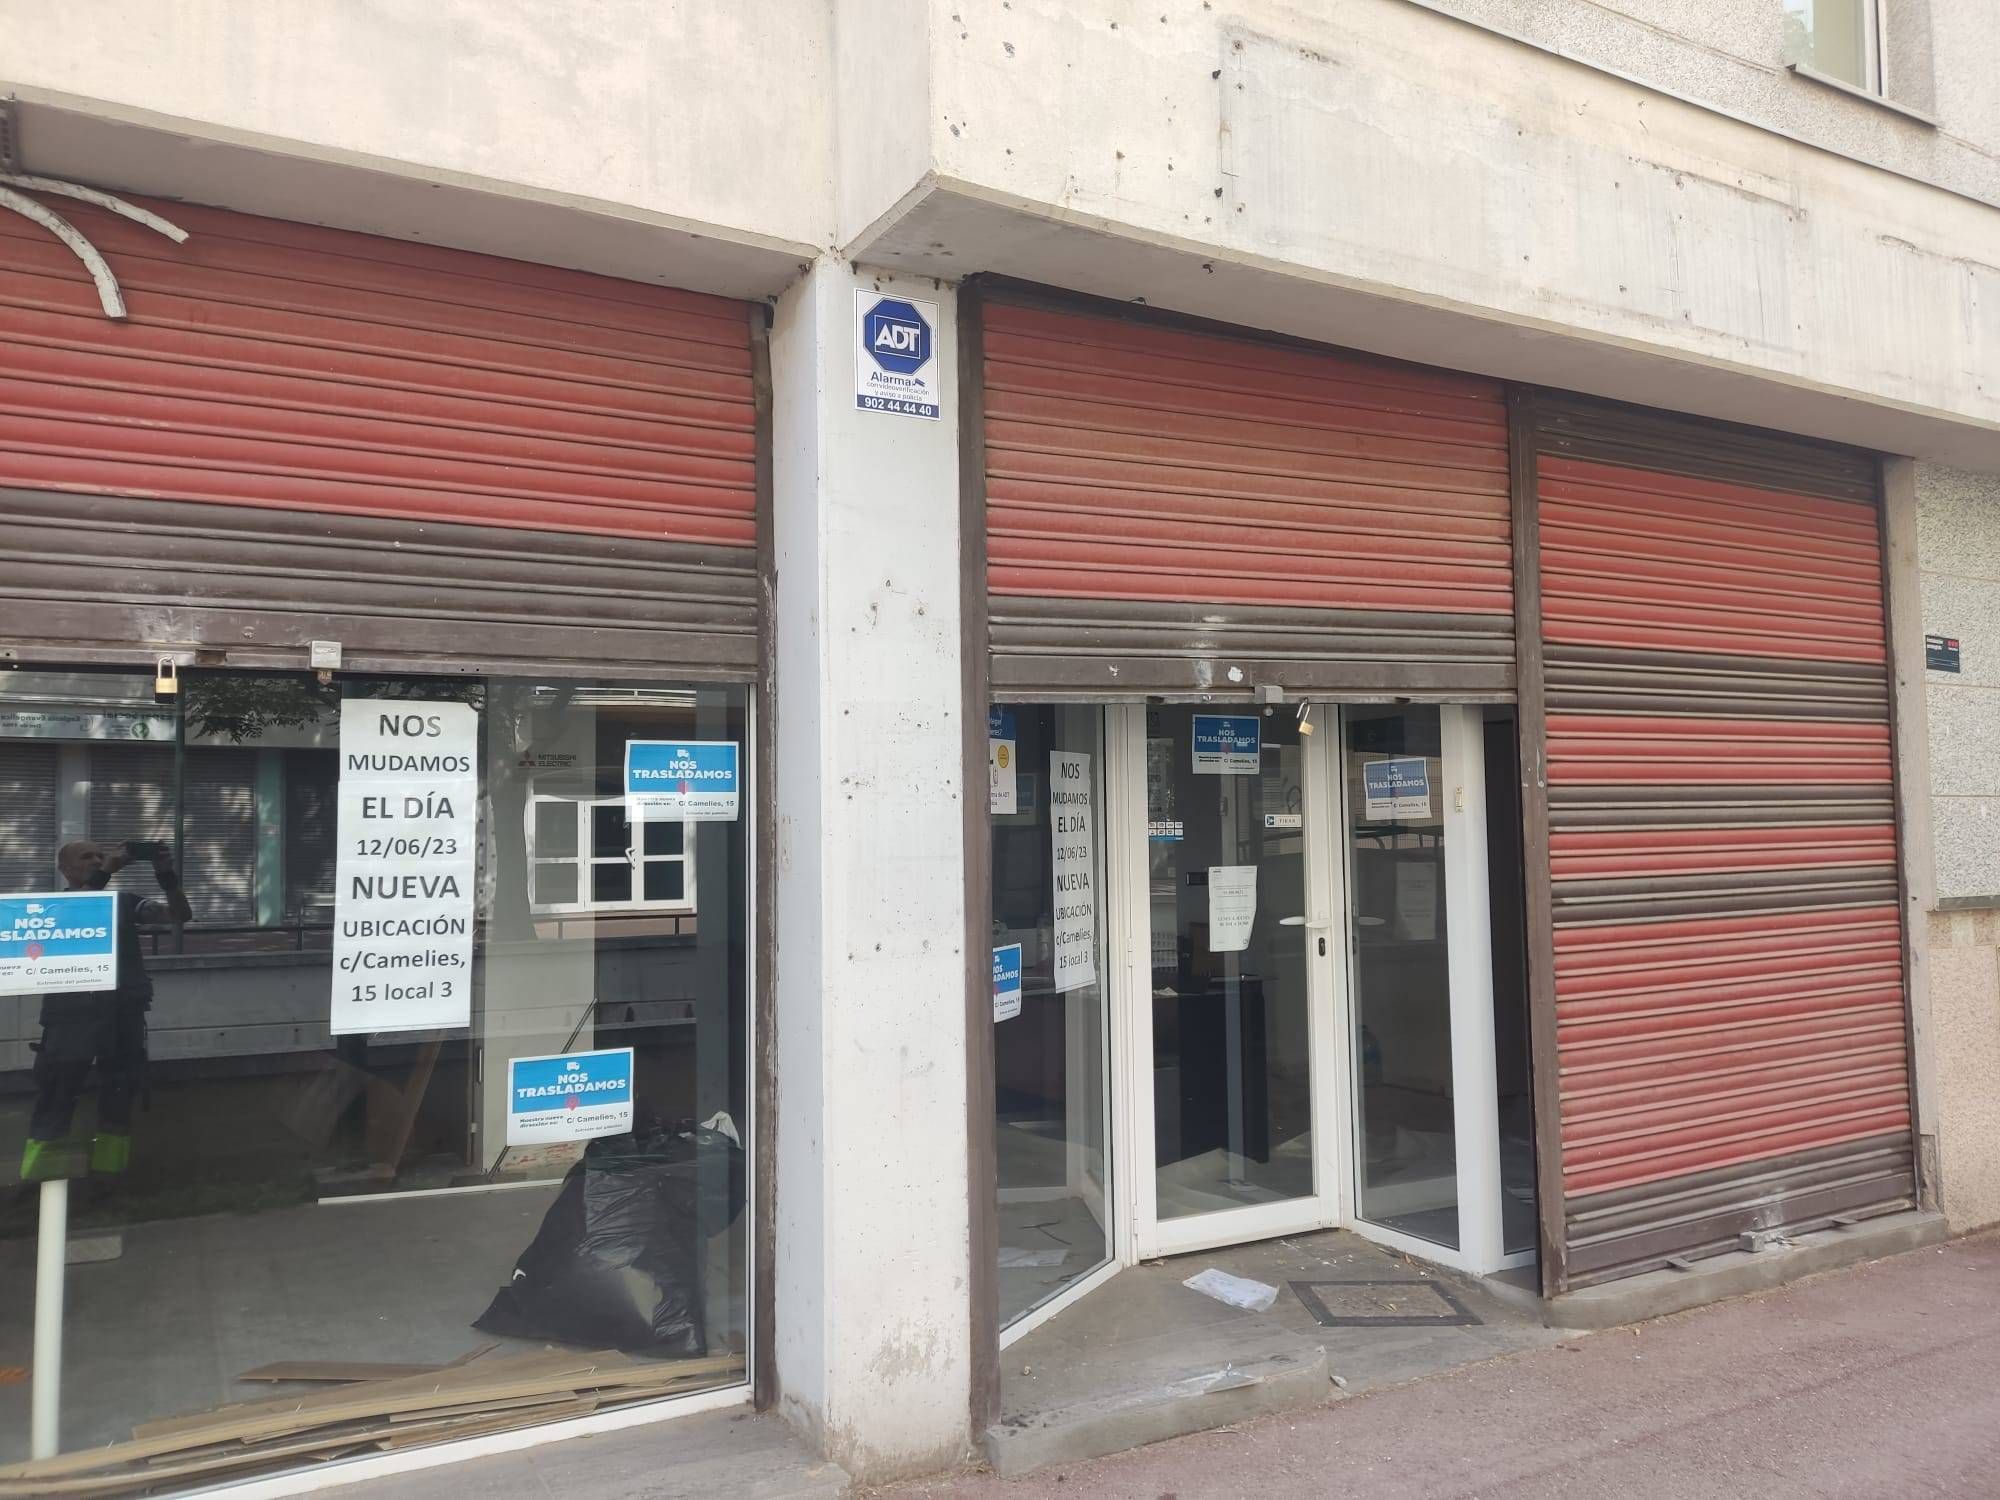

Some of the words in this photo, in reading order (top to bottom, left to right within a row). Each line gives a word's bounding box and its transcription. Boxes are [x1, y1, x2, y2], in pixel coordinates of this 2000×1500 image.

[875, 323, 920, 352] ADT
[871, 371, 912, 387] Alarma
[865, 397, 884, 409] 902
[887, 400, 900, 411] 44
[904, 402, 916, 414] 44
[919, 404, 932, 416] 40
[379, 714, 442, 737] NOS
[1197, 736, 1256, 744] TRASLADAMOS
[348, 754, 470, 773] MUDAMOS
[669, 760, 697, 770] NOS
[1061, 762, 1080, 780] NOS
[632, 770, 732, 779] TRASLADAMOS
[1387, 773, 1403, 781] NOS
[1368, 780, 1424, 789] TRASLADAMOS
[362, 797, 393, 819] EL
[404, 791, 454, 819] DÍA
[1052, 791, 1088, 805] MUDAMOS
[1058, 816, 1068, 833] EL
[1070, 811, 1086, 833] DÍA
[357, 837, 457, 858] 12/06/23
[1057, 845, 1087, 862] 12/06/23
[352, 875, 460, 900] NUEVA
[1057, 872, 1090, 892] NUEVA
[1056, 901, 1092, 920] UBICACIÓN
[14, 917, 57, 930] NOS
[343, 914, 465, 938] UBICACIÓN
[1056, 928, 1092, 947] c/Camelies,
[340, 950, 466, 973] c/Camelies,
[1059, 955, 1067, 969] 15
[1068, 951, 1083, 967] local
[1084, 951, 1088, 964] 3
[25, 968, 37, 976] C/
[40, 966, 93, 975] Camelies,
[97, 964, 109, 972] 15
[352, 985, 377, 1002] 15
[385, 982, 433, 1001] local
[440, 981, 452, 998] 3
[558, 1072, 588, 1084] NOS
[517, 1079, 626, 1098] TRASLADAMOS
